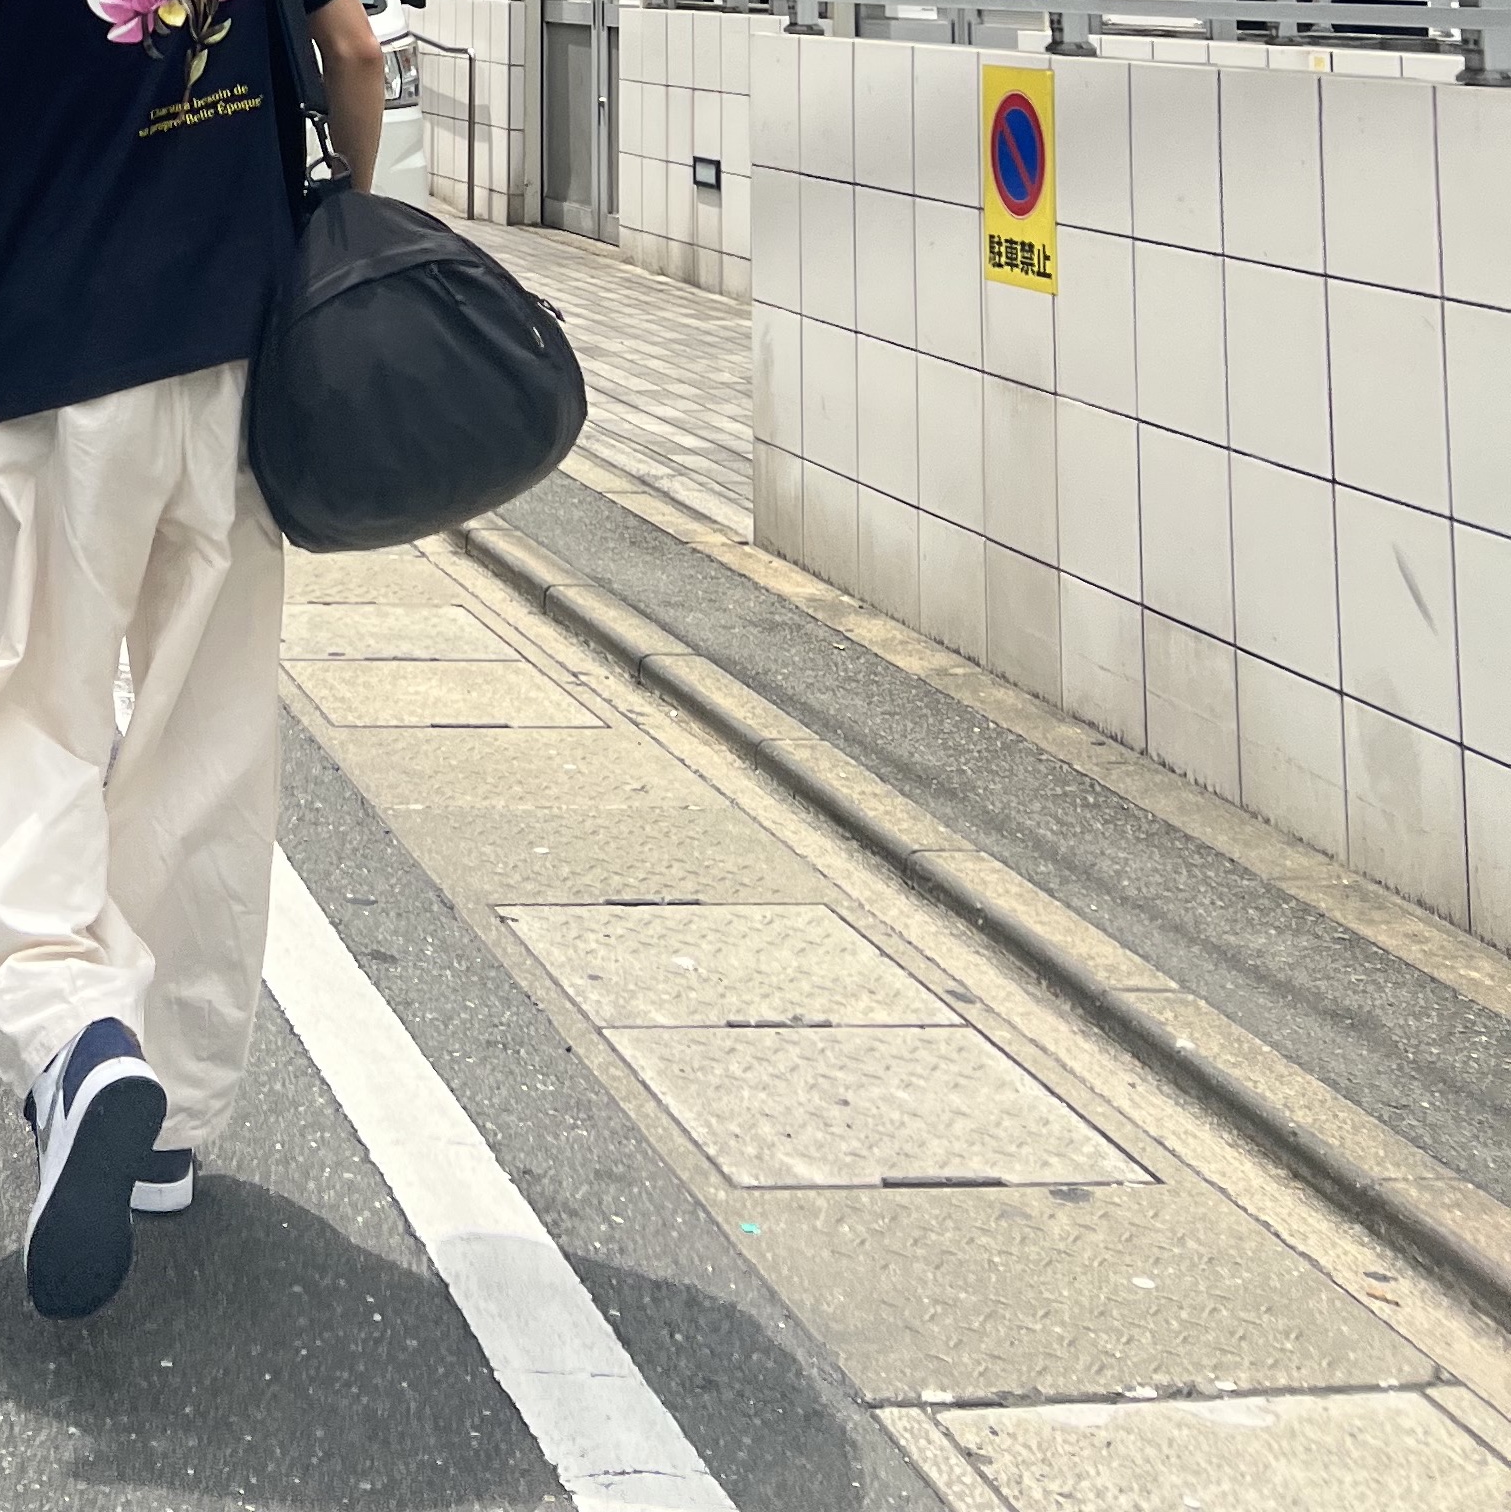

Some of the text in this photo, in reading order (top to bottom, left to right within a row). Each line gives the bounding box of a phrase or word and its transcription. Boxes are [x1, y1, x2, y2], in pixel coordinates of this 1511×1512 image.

[192, 89, 231, 108] besoin
[233, 84, 248, 96] de
[989, 234, 1052, 279] 駐車禁止
